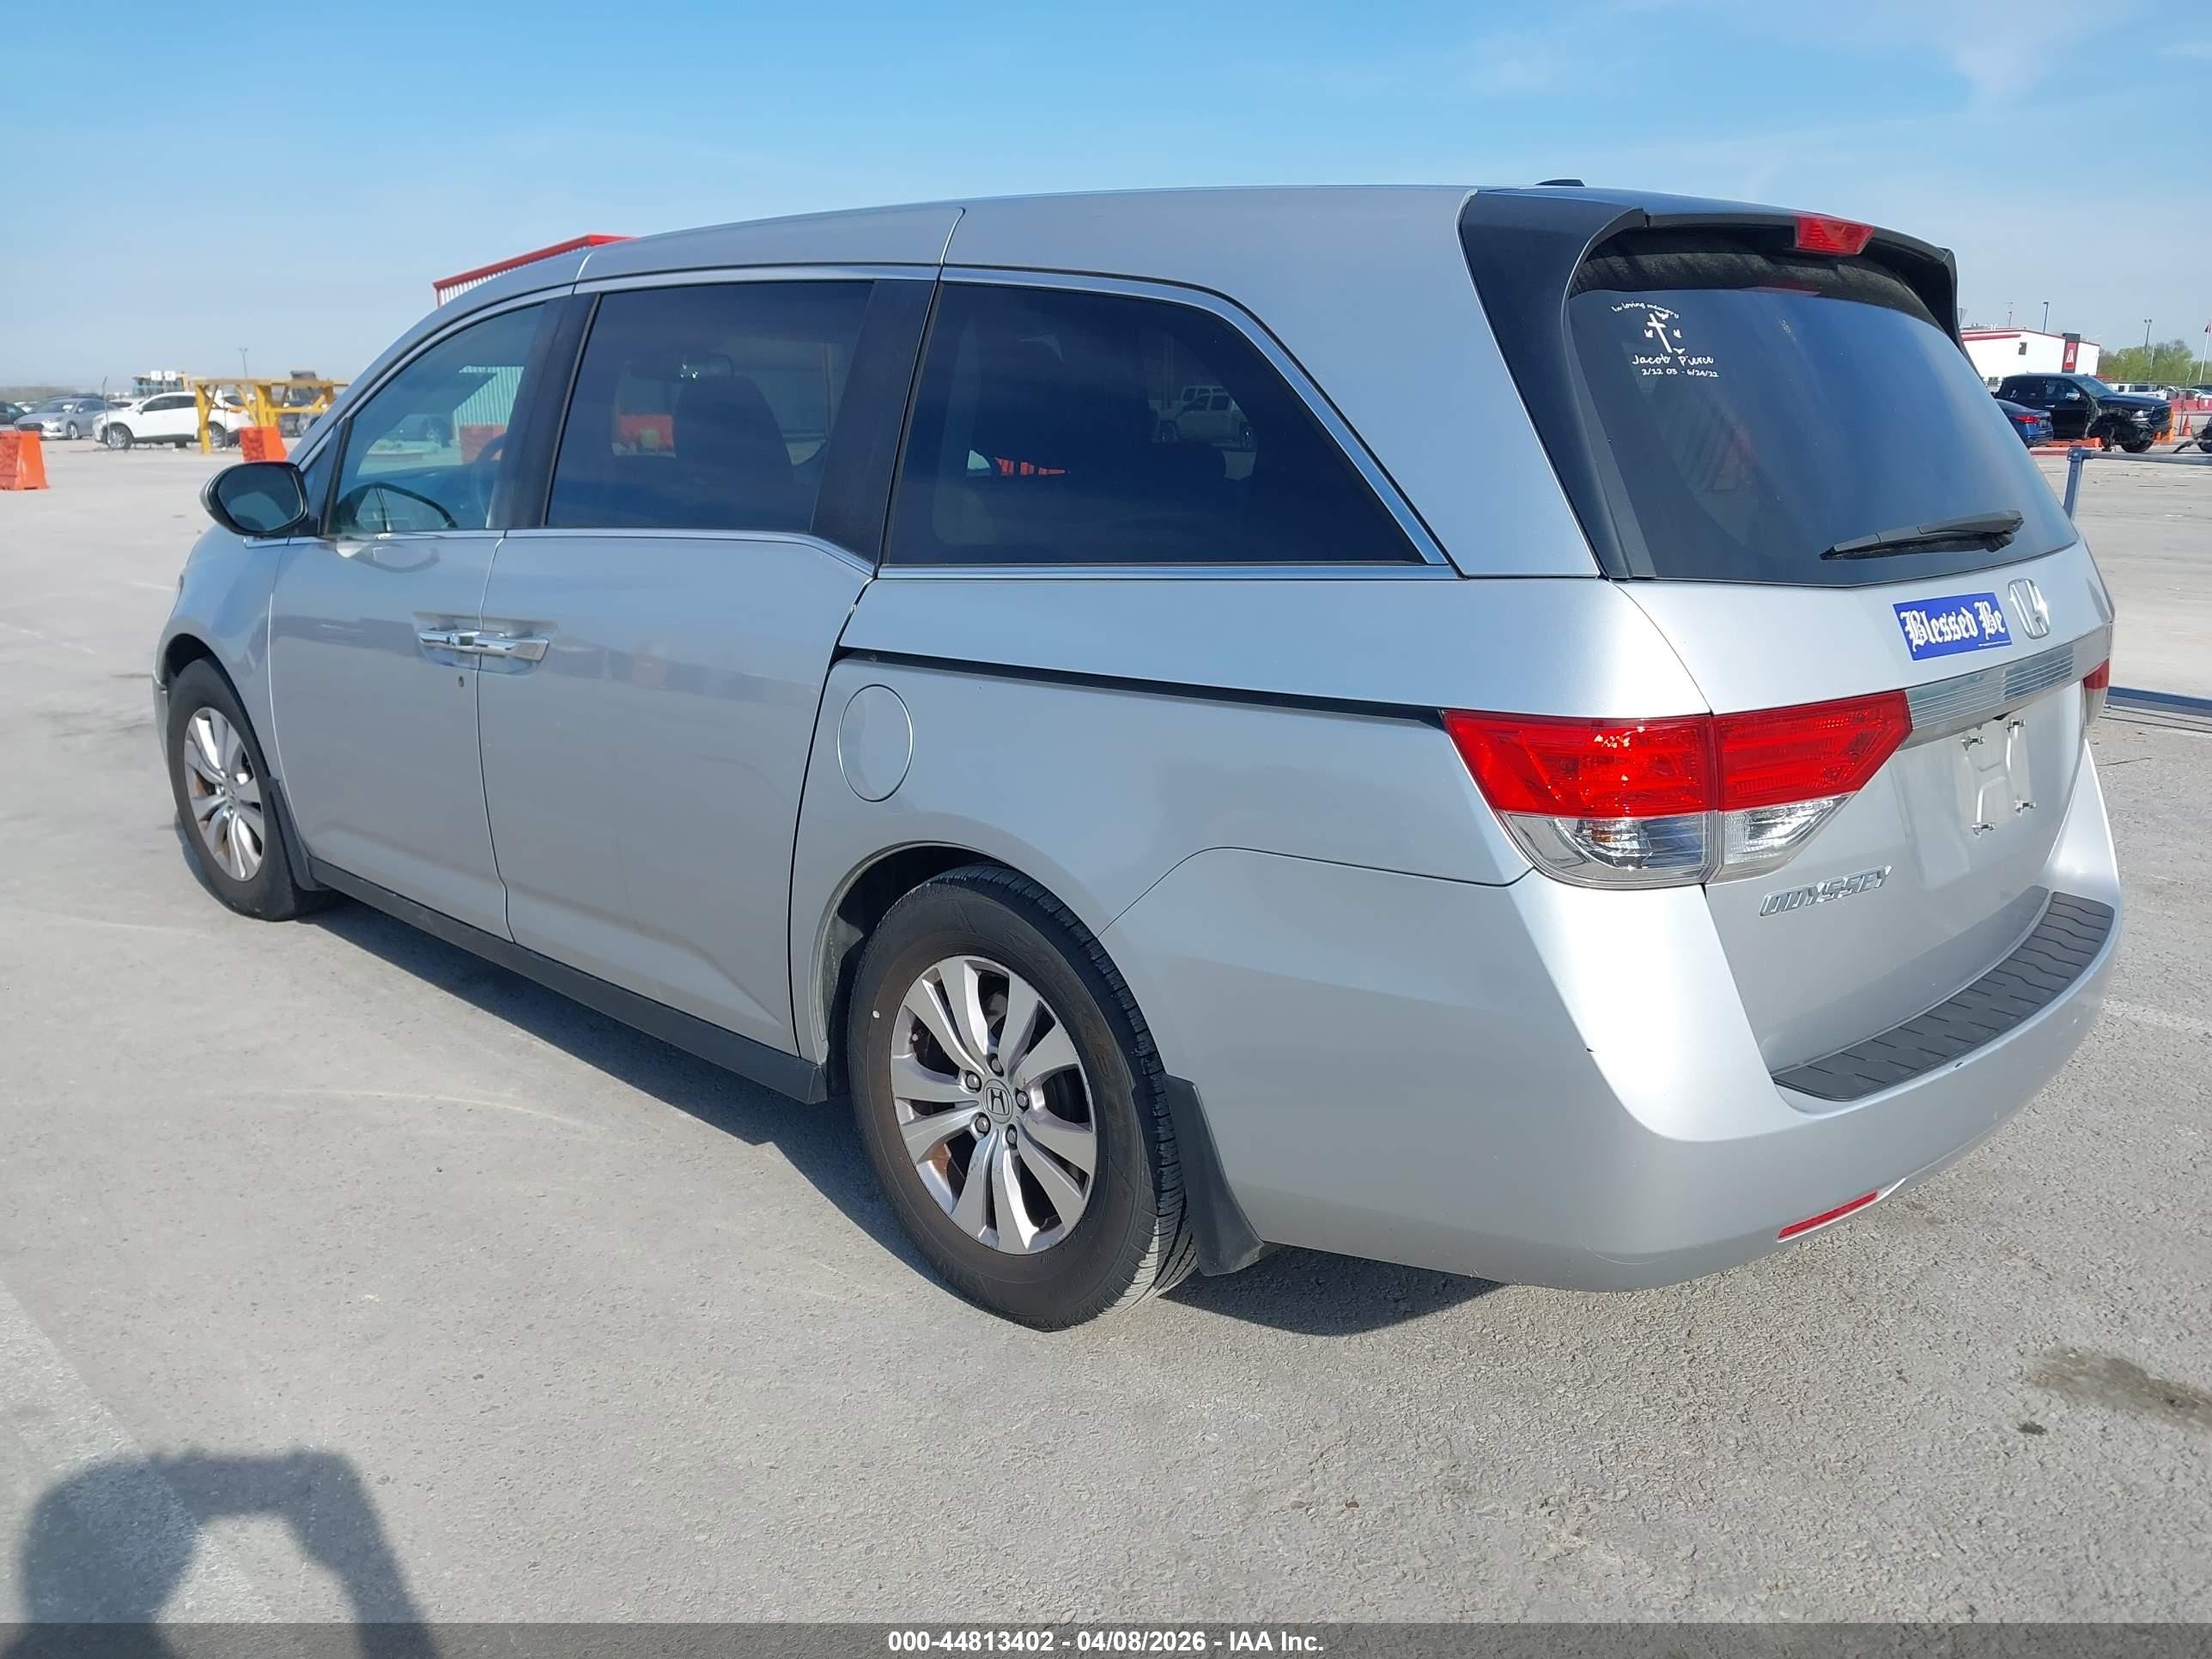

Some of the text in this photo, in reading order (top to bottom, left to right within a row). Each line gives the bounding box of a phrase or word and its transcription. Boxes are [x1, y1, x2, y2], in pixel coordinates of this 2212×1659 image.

[1621, 301, 1645, 309] loving
[1647, 303, 1680, 319] memory
[1632, 353, 1714, 366] Jacob Pierce
[1899, 600, 2006, 653] Blessed Be
[1759, 865, 1893, 916] ODYSSEY
